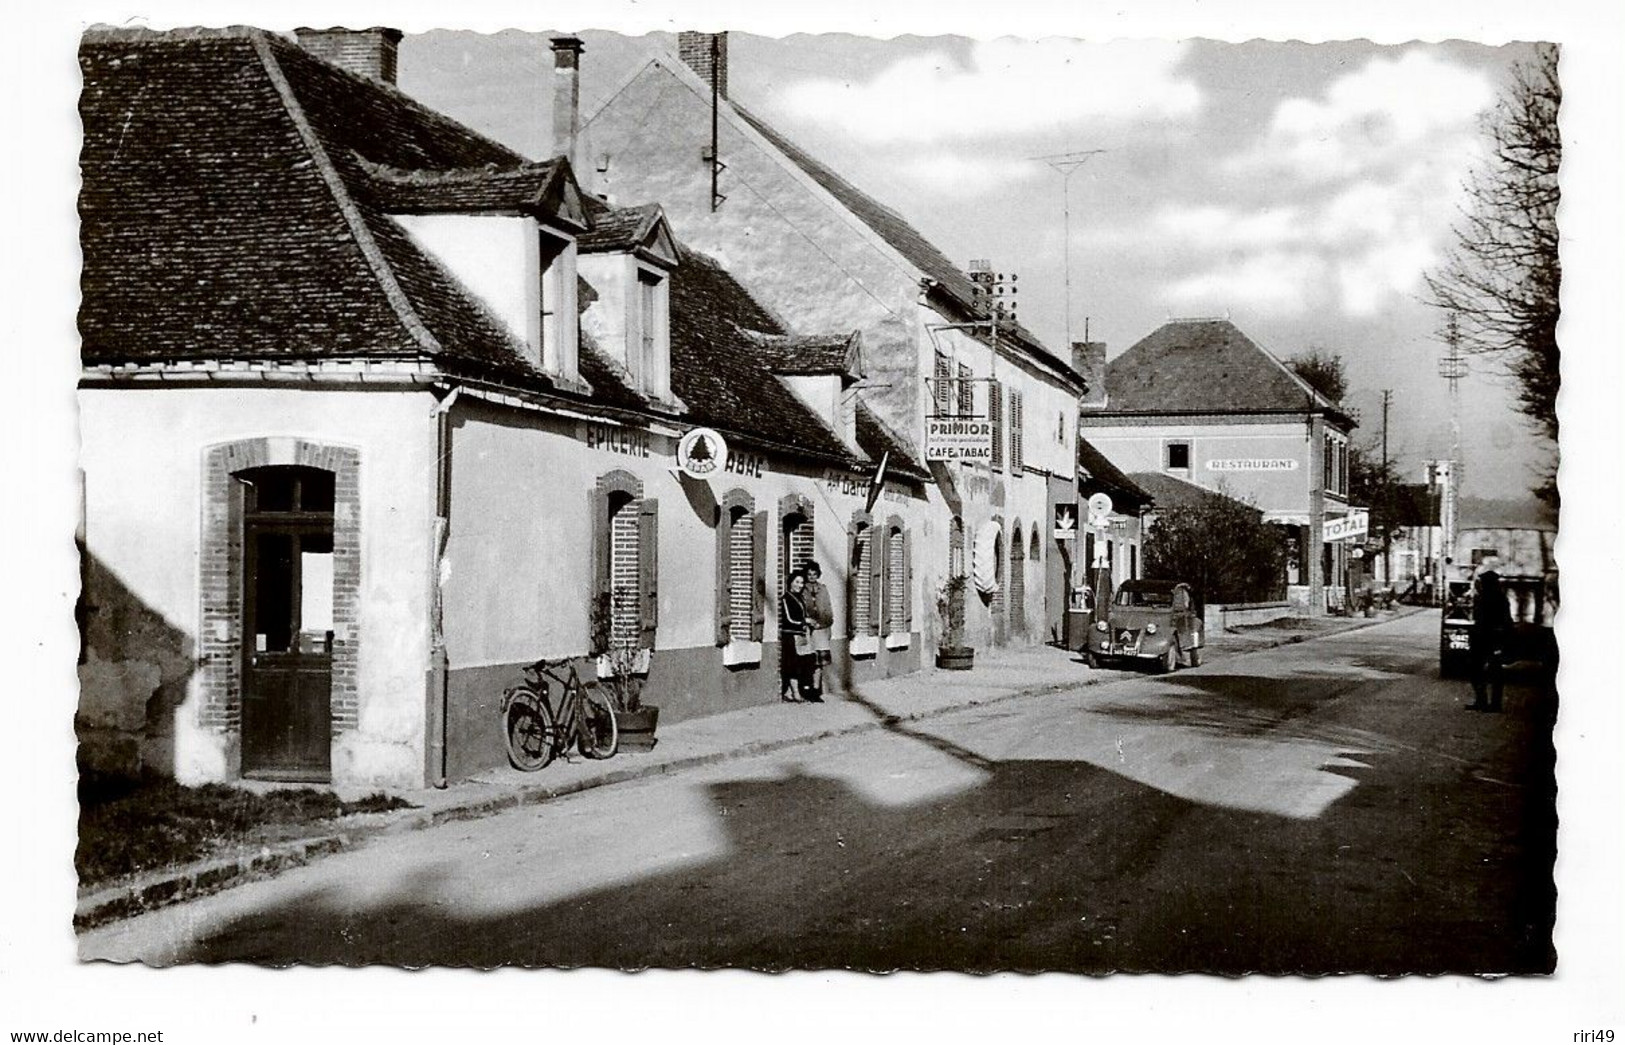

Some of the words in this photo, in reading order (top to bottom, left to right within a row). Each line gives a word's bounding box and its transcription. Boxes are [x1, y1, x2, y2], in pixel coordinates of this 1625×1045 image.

[931, 423, 990, 435] PRIMIOR
[587, 424, 649, 458] EPICERIE
[959, 447, 990, 458] TABAC
[724, 450, 763, 479] ABAC
[1212, 460, 1293, 469] RESTAURANT
[1325, 518, 1366, 537] TOTAL
